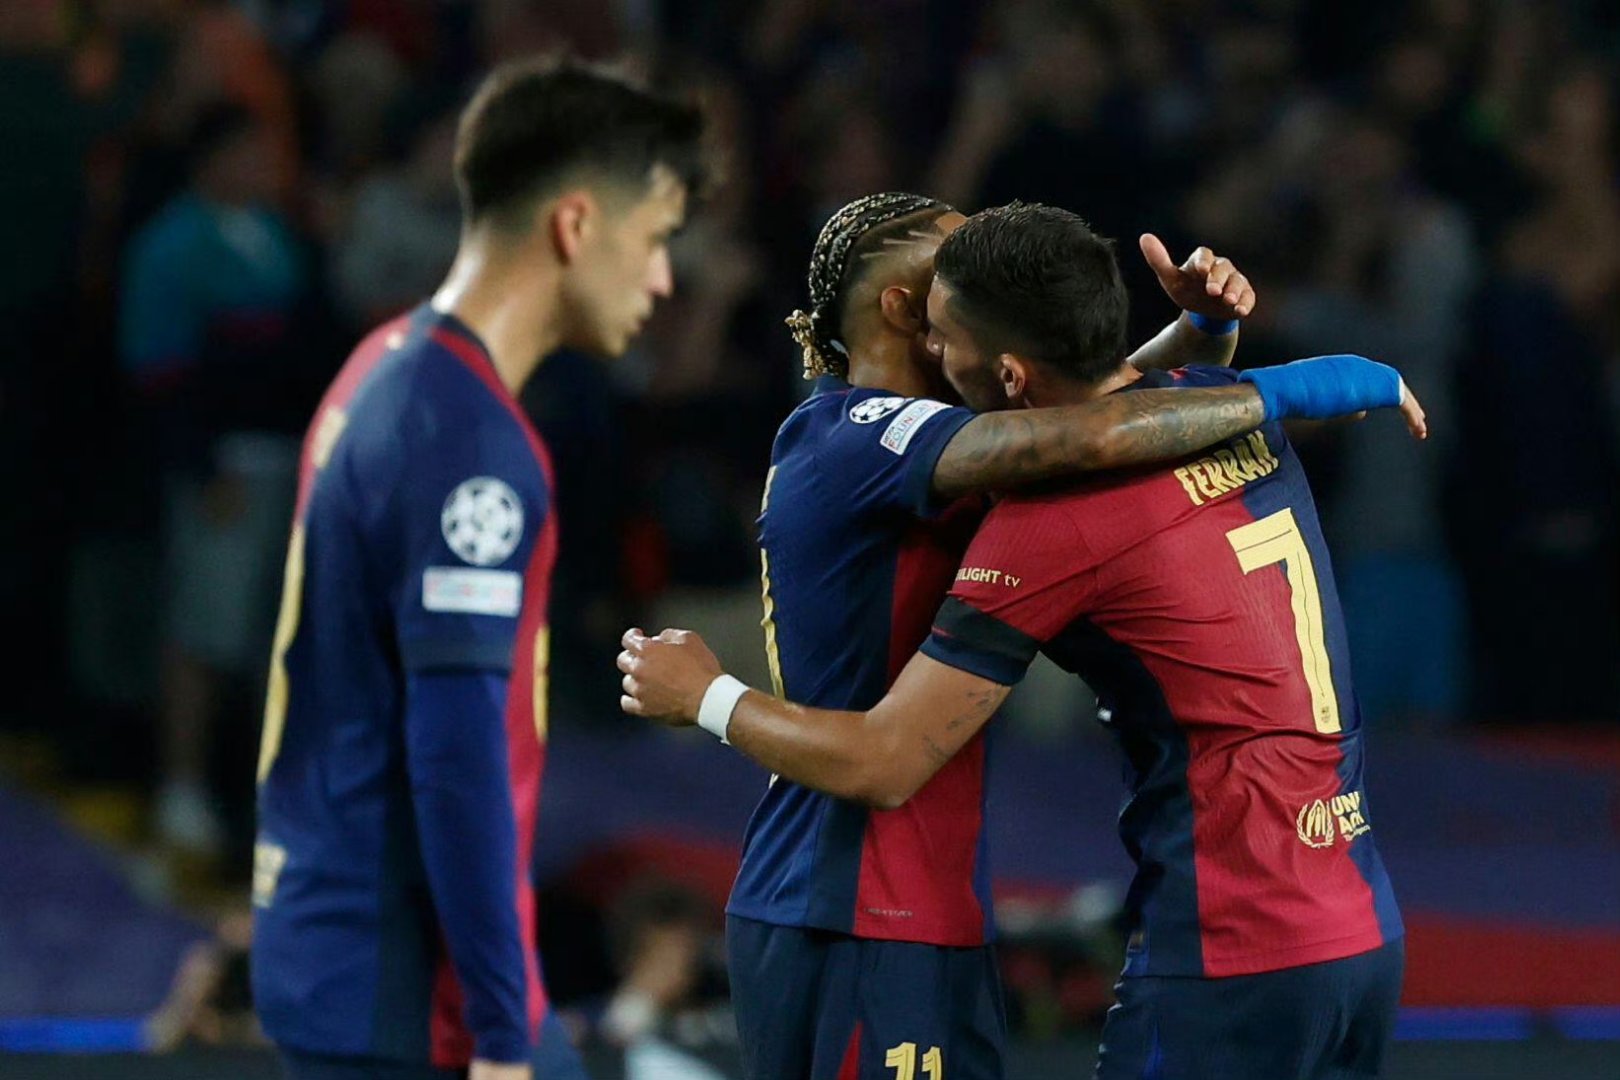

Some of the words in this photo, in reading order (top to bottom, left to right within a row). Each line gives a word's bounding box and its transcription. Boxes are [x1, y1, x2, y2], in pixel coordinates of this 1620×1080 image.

[1173, 429, 1279, 506] FERRAN
[1004, 574, 1021, 587] tv
[1225, 507, 1342, 734] 7
